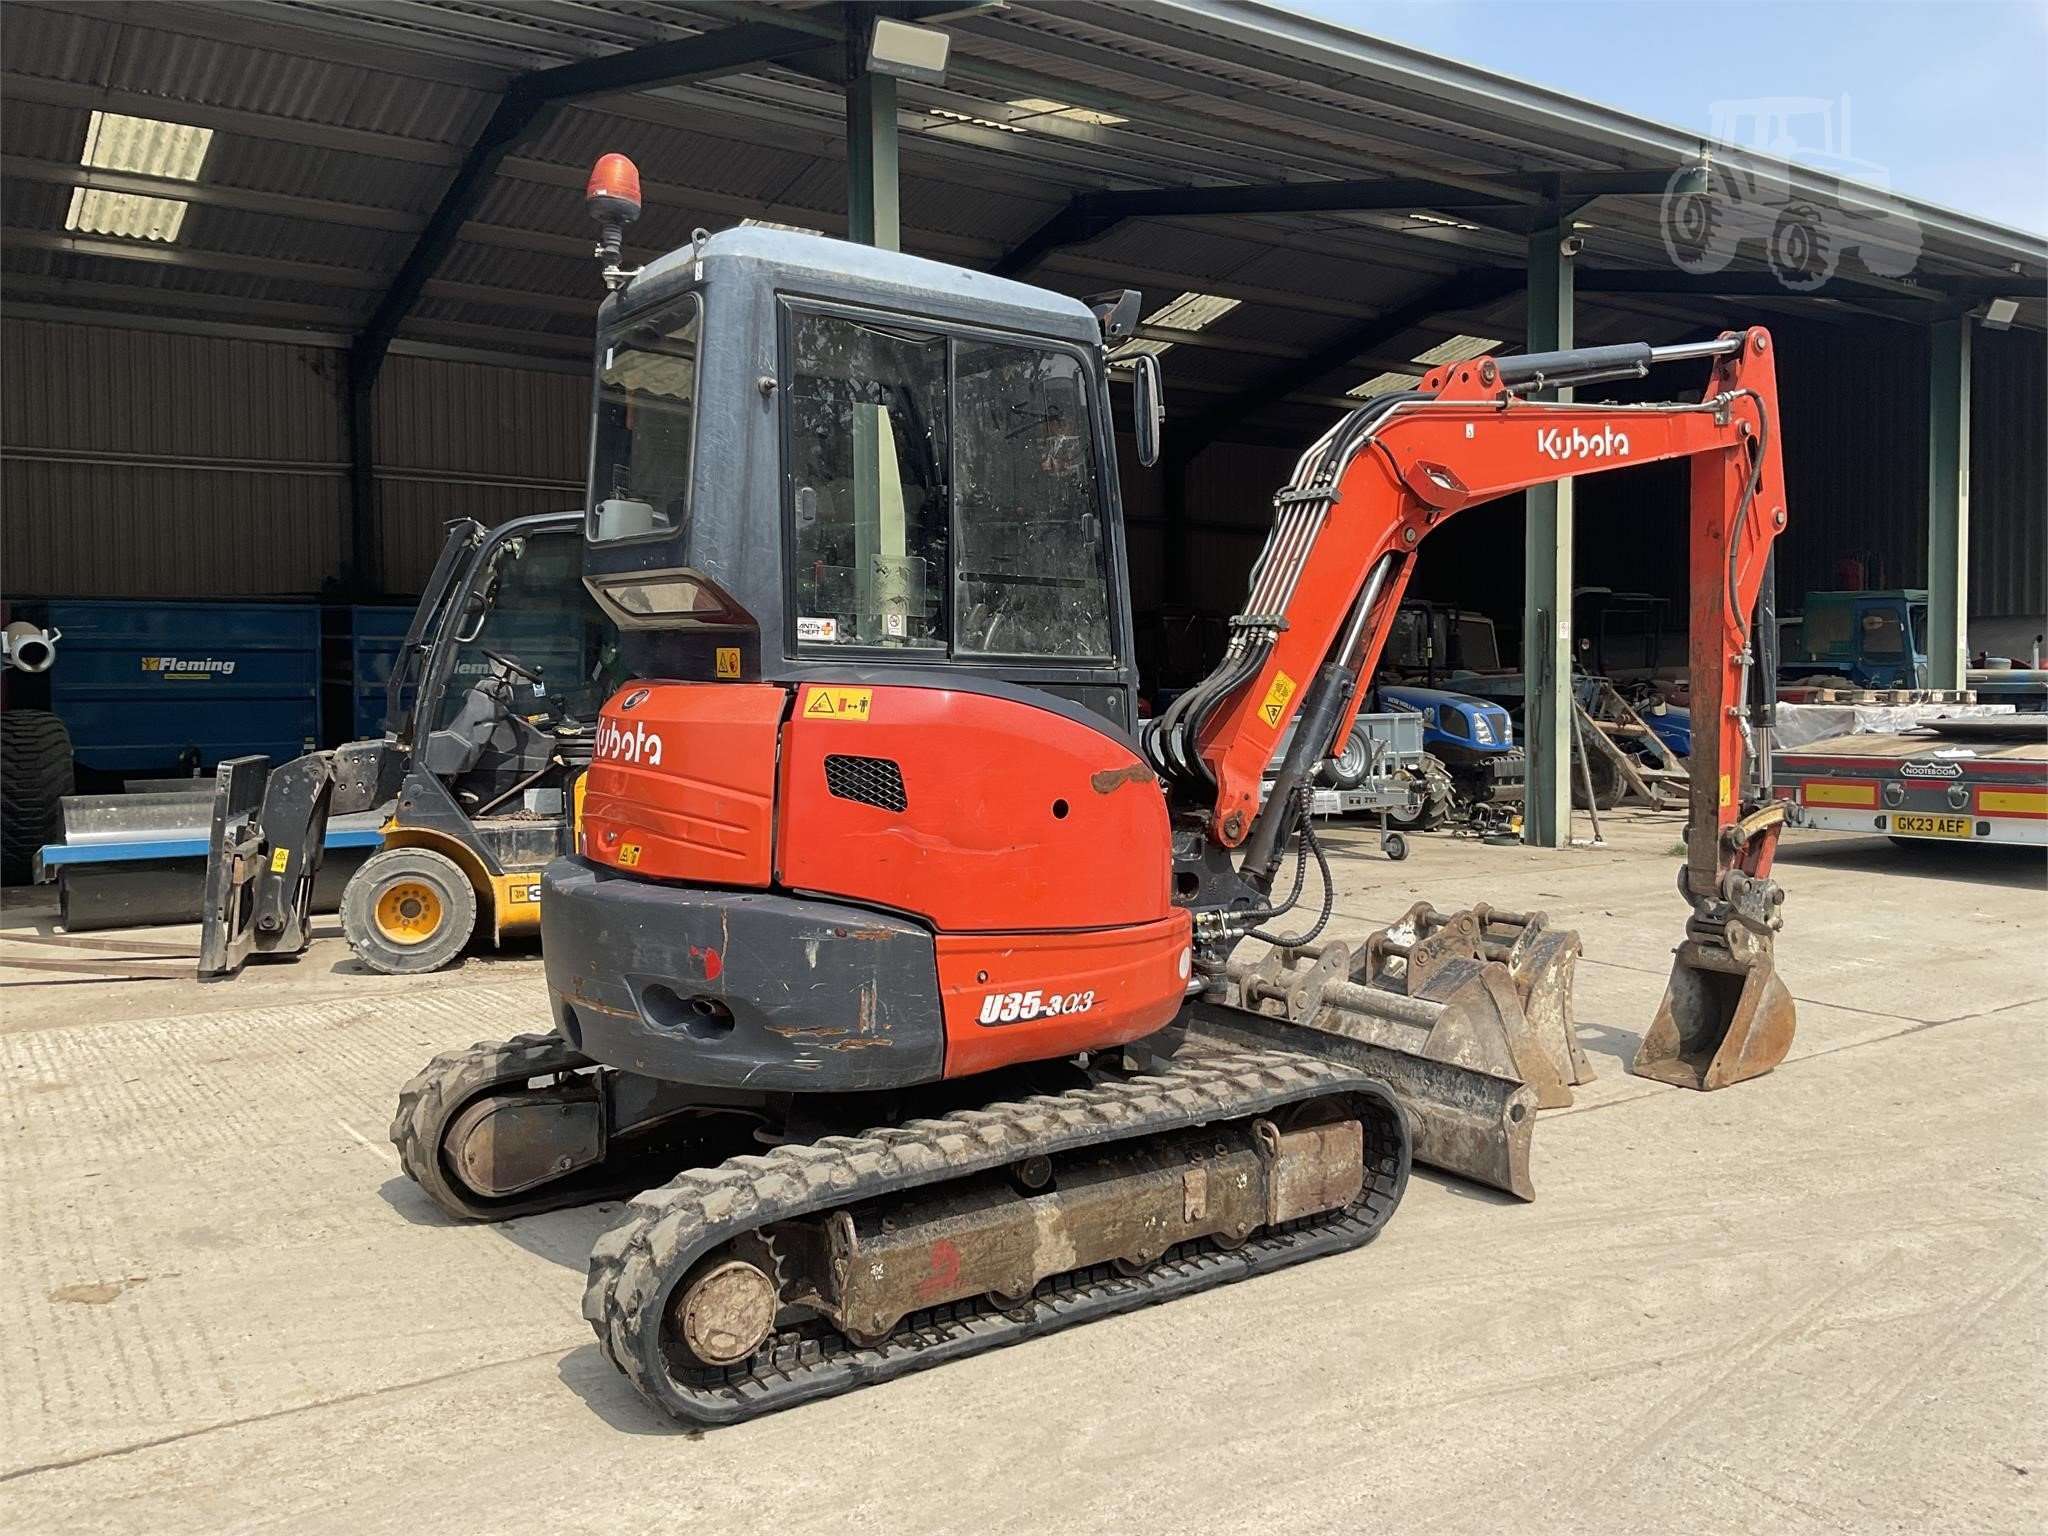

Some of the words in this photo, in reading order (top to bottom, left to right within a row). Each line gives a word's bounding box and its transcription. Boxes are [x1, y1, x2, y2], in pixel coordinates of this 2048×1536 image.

[1537, 422, 1629, 460] Kubota
[159, 657, 236, 675] Fleming
[595, 715, 662, 766] Kubota
[1905, 767, 1957, 776] NOOTEBOOM
[1897, 816, 1934, 833] GK23
[1937, 818, 1965, 834] AEF
